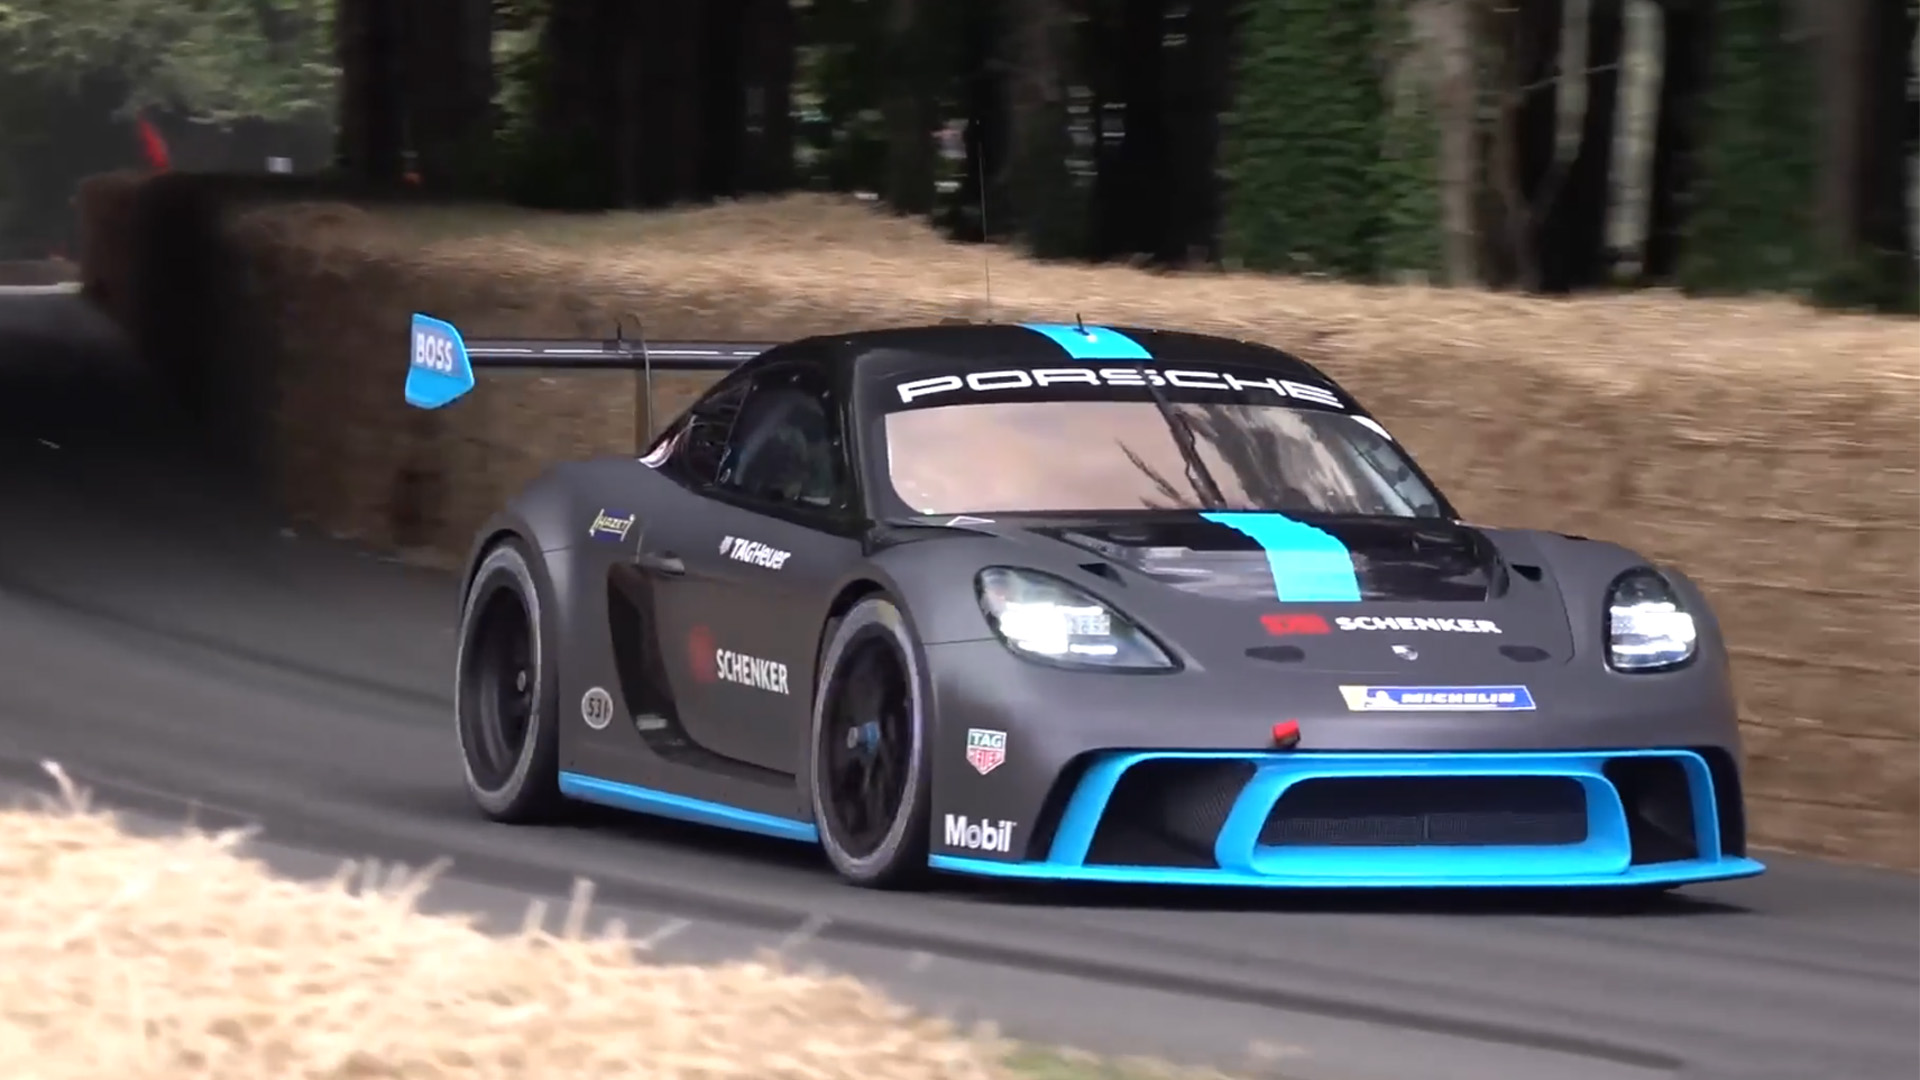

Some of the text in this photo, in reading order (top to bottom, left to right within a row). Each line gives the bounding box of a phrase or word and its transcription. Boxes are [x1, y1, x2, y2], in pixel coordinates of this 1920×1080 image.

[415, 334, 453, 372] BOSS
[896, 368, 1345, 409] PORSCHE
[1335, 616, 1503, 634] SCHENKER
[716, 648, 789, 695] SCHENKER
[1401, 692, 1516, 704] MICHELIN
[972, 732, 1003, 748] TAG
[944, 813, 1013, 853] Mobil
